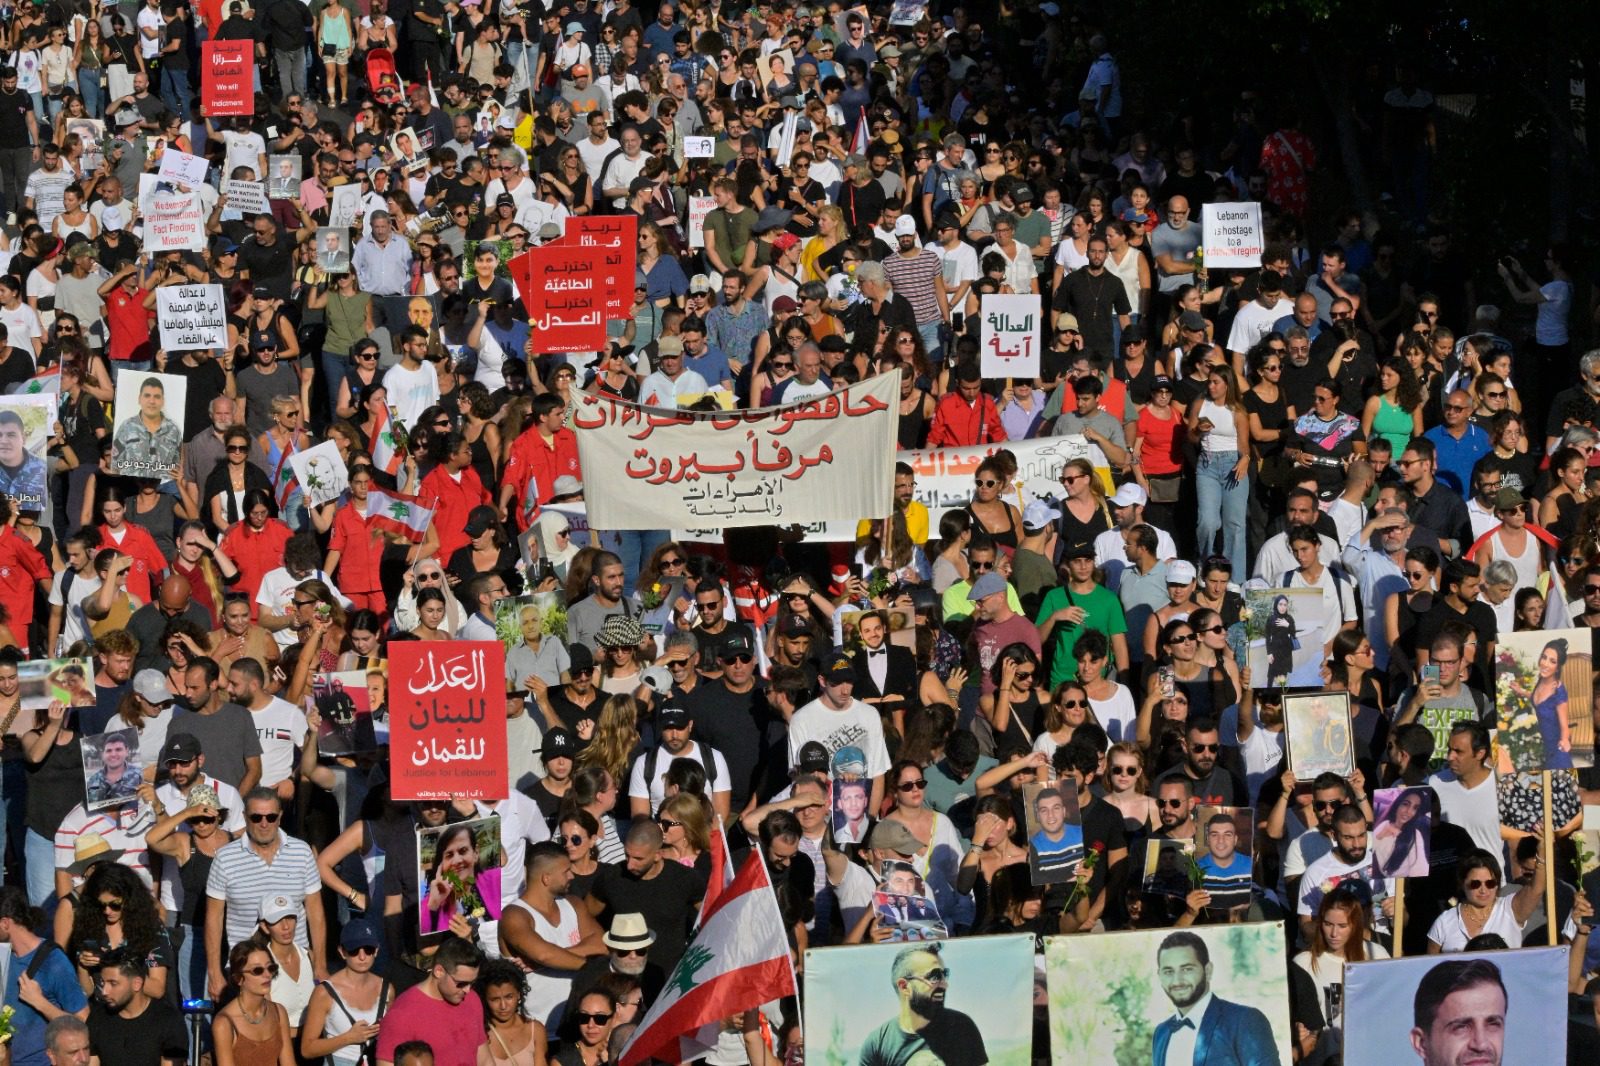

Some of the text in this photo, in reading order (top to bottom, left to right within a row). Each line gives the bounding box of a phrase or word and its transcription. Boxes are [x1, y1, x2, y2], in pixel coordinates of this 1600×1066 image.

[163, 198, 193, 210] demand
[1217, 211, 1249, 221] Lebanon
[153, 222, 196, 234] Fact Finding
[1222, 225, 1253, 237] hostage
[161, 235, 190, 247] Mission
[1227, 237, 1242, 247] to a
[543, 260, 593, 275] اخترتم
[179, 287, 206, 299] لا عدالة
[168, 300, 219, 315] في ظل هيمنة
[544, 297, 593, 312] اخترنا
[537, 311, 601, 332] العدل
[987, 312, 1033, 332] العدالة
[177, 333, 202, 345] القضاء
[625, 428, 834, 486] مرفأ بيروت
[686, 497, 784, 520] والمدينة
[408, 698, 487, 734] للبنان
[411, 736, 486, 767] للقمان
[454, 768, 497, 777] Lebanon
